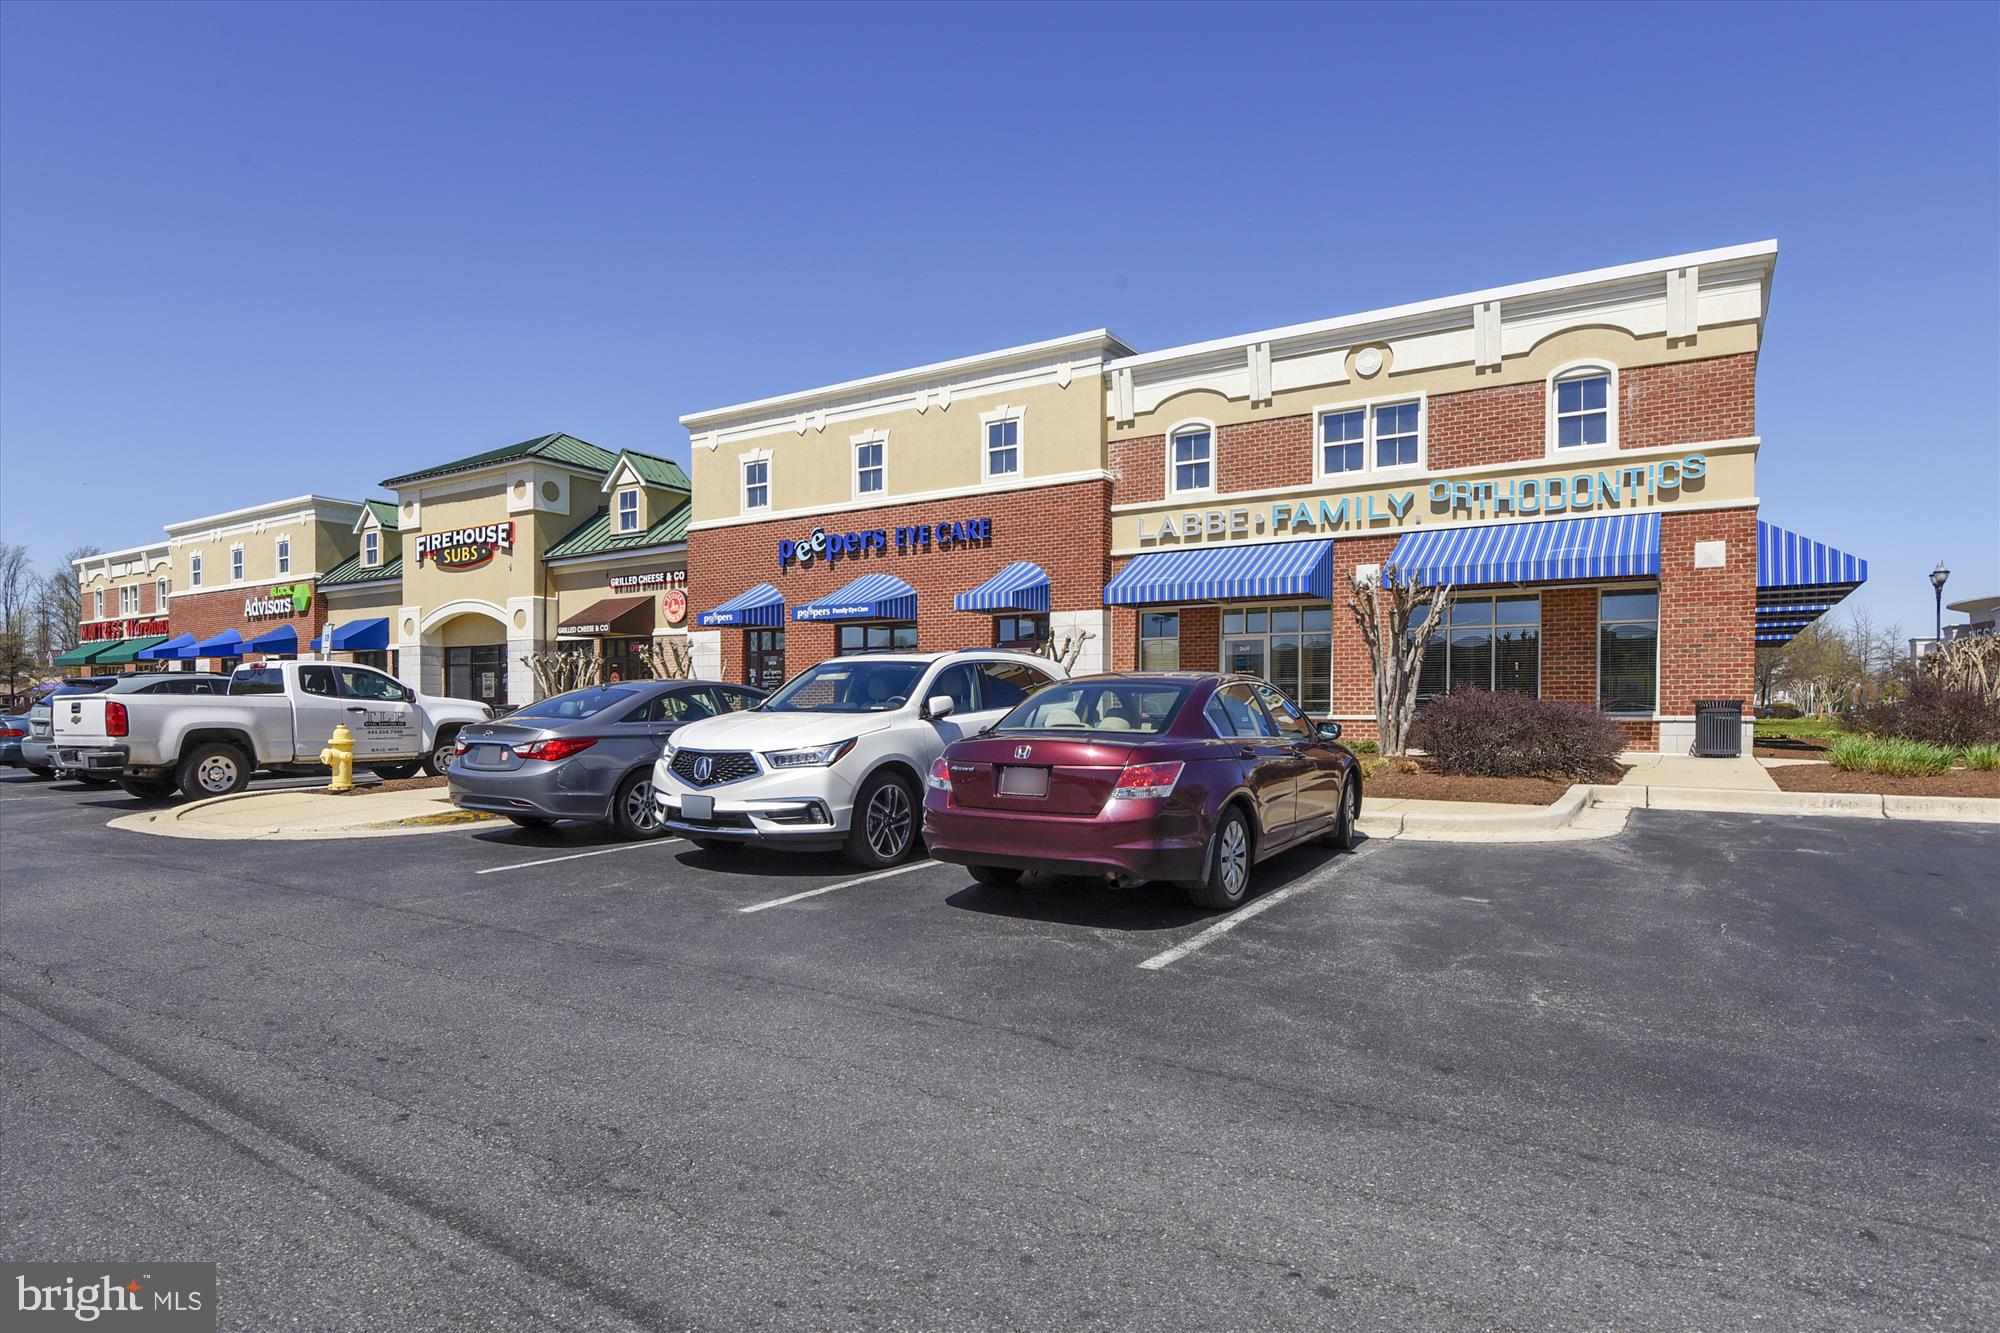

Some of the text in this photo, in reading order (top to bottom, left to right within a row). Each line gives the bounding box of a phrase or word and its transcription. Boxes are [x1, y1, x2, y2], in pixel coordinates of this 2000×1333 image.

[1138, 454, 1707, 539] LABBE FAMILY ORTHODONTICS
[415, 522, 510, 562] FIREHOUSE
[778, 517, 992, 567] peepers EYE CARE
[443, 545, 478, 563] SUBS
[610, 571, 685, 586] GRILLED CHEESE & CO
[244, 595, 292, 617] Advisors
[797, 605, 831, 620] peepers
[703, 611, 733, 625] peepers
[80, 619, 169, 641] MATTRESS Warehous
